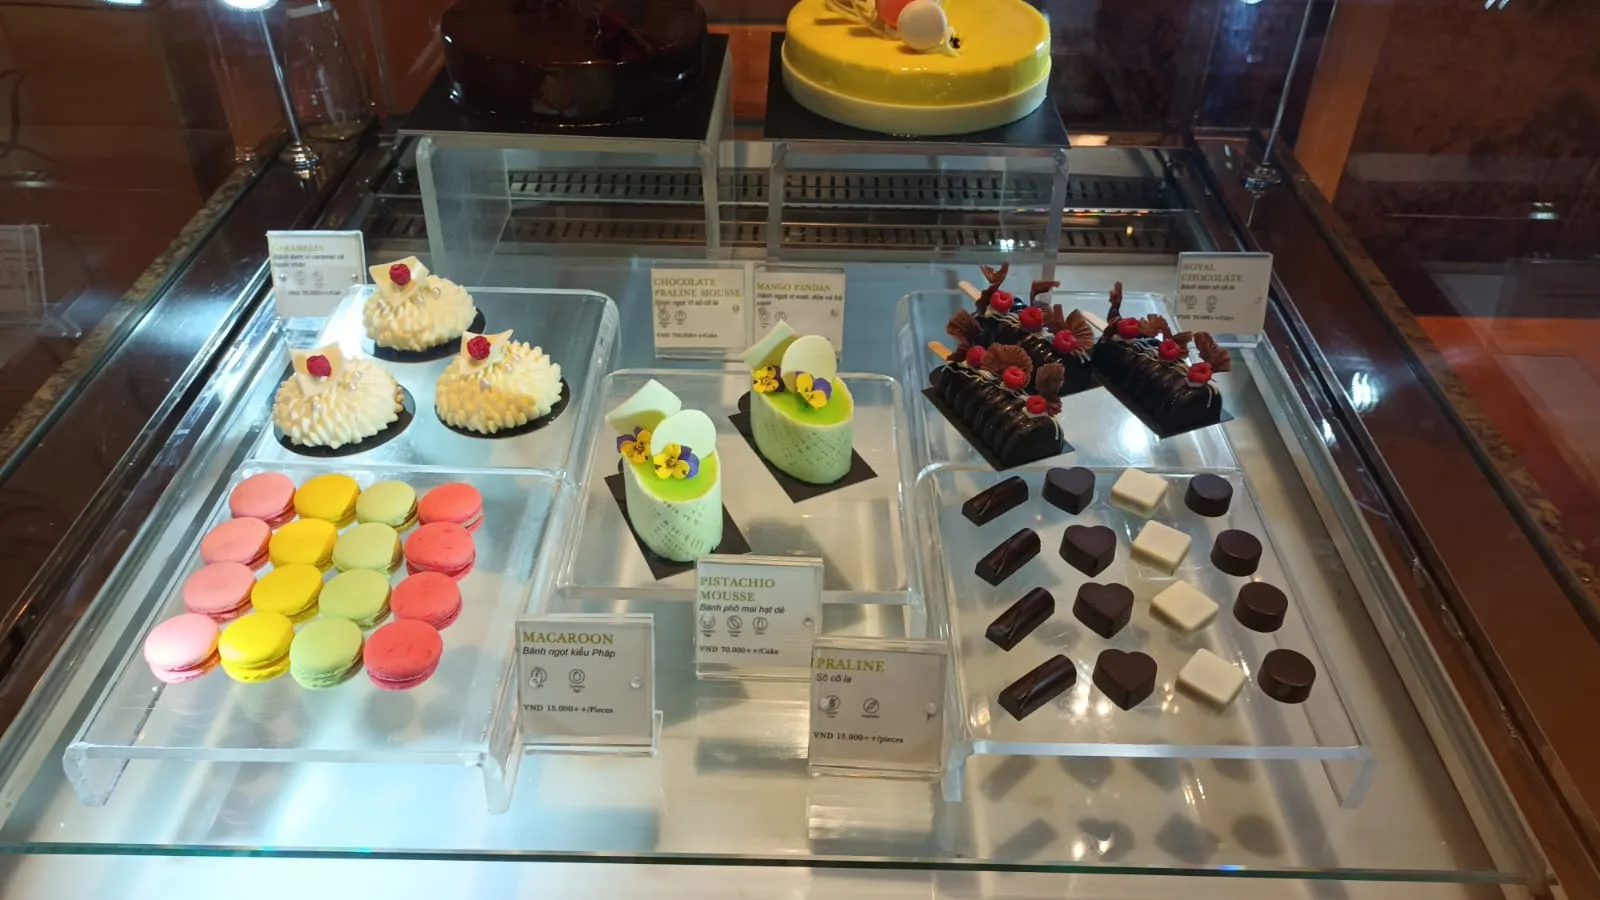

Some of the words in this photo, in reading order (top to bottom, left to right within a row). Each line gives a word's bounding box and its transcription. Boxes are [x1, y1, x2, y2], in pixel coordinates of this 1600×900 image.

[1183, 262, 1215, 271] ROYAL
[654, 278, 716, 286] CHOCOLATE
[1181, 273, 1243, 282] CHOCOLATE
[757, 282, 792, 291] MANGO
[795, 284, 831, 292] PANDAN
[654, 289, 695, 297] PRALINE
[700, 289, 742, 297] MOUSSE
[700, 576, 776, 589] PISTACHIO
[700, 590, 756, 602] MOUSSE
[700, 603, 722, 612] Bánh
[758, 605, 773, 615] hạt
[522, 631, 615, 645] MACAROON
[522, 646, 546, 656] Bánh
[548, 649, 569, 658] ngọt
[570, 646, 590, 657] kiểu
[591, 648, 616, 659] Pháp
[699, 645, 719, 653] VND
[816, 657, 886, 673] PRALINE
[815, 673, 828, 682] Sô
[830, 674, 842, 682] cô
[843, 674, 852, 684] la
[523, 704, 544, 712] VND
[813, 731, 834, 740] VND
